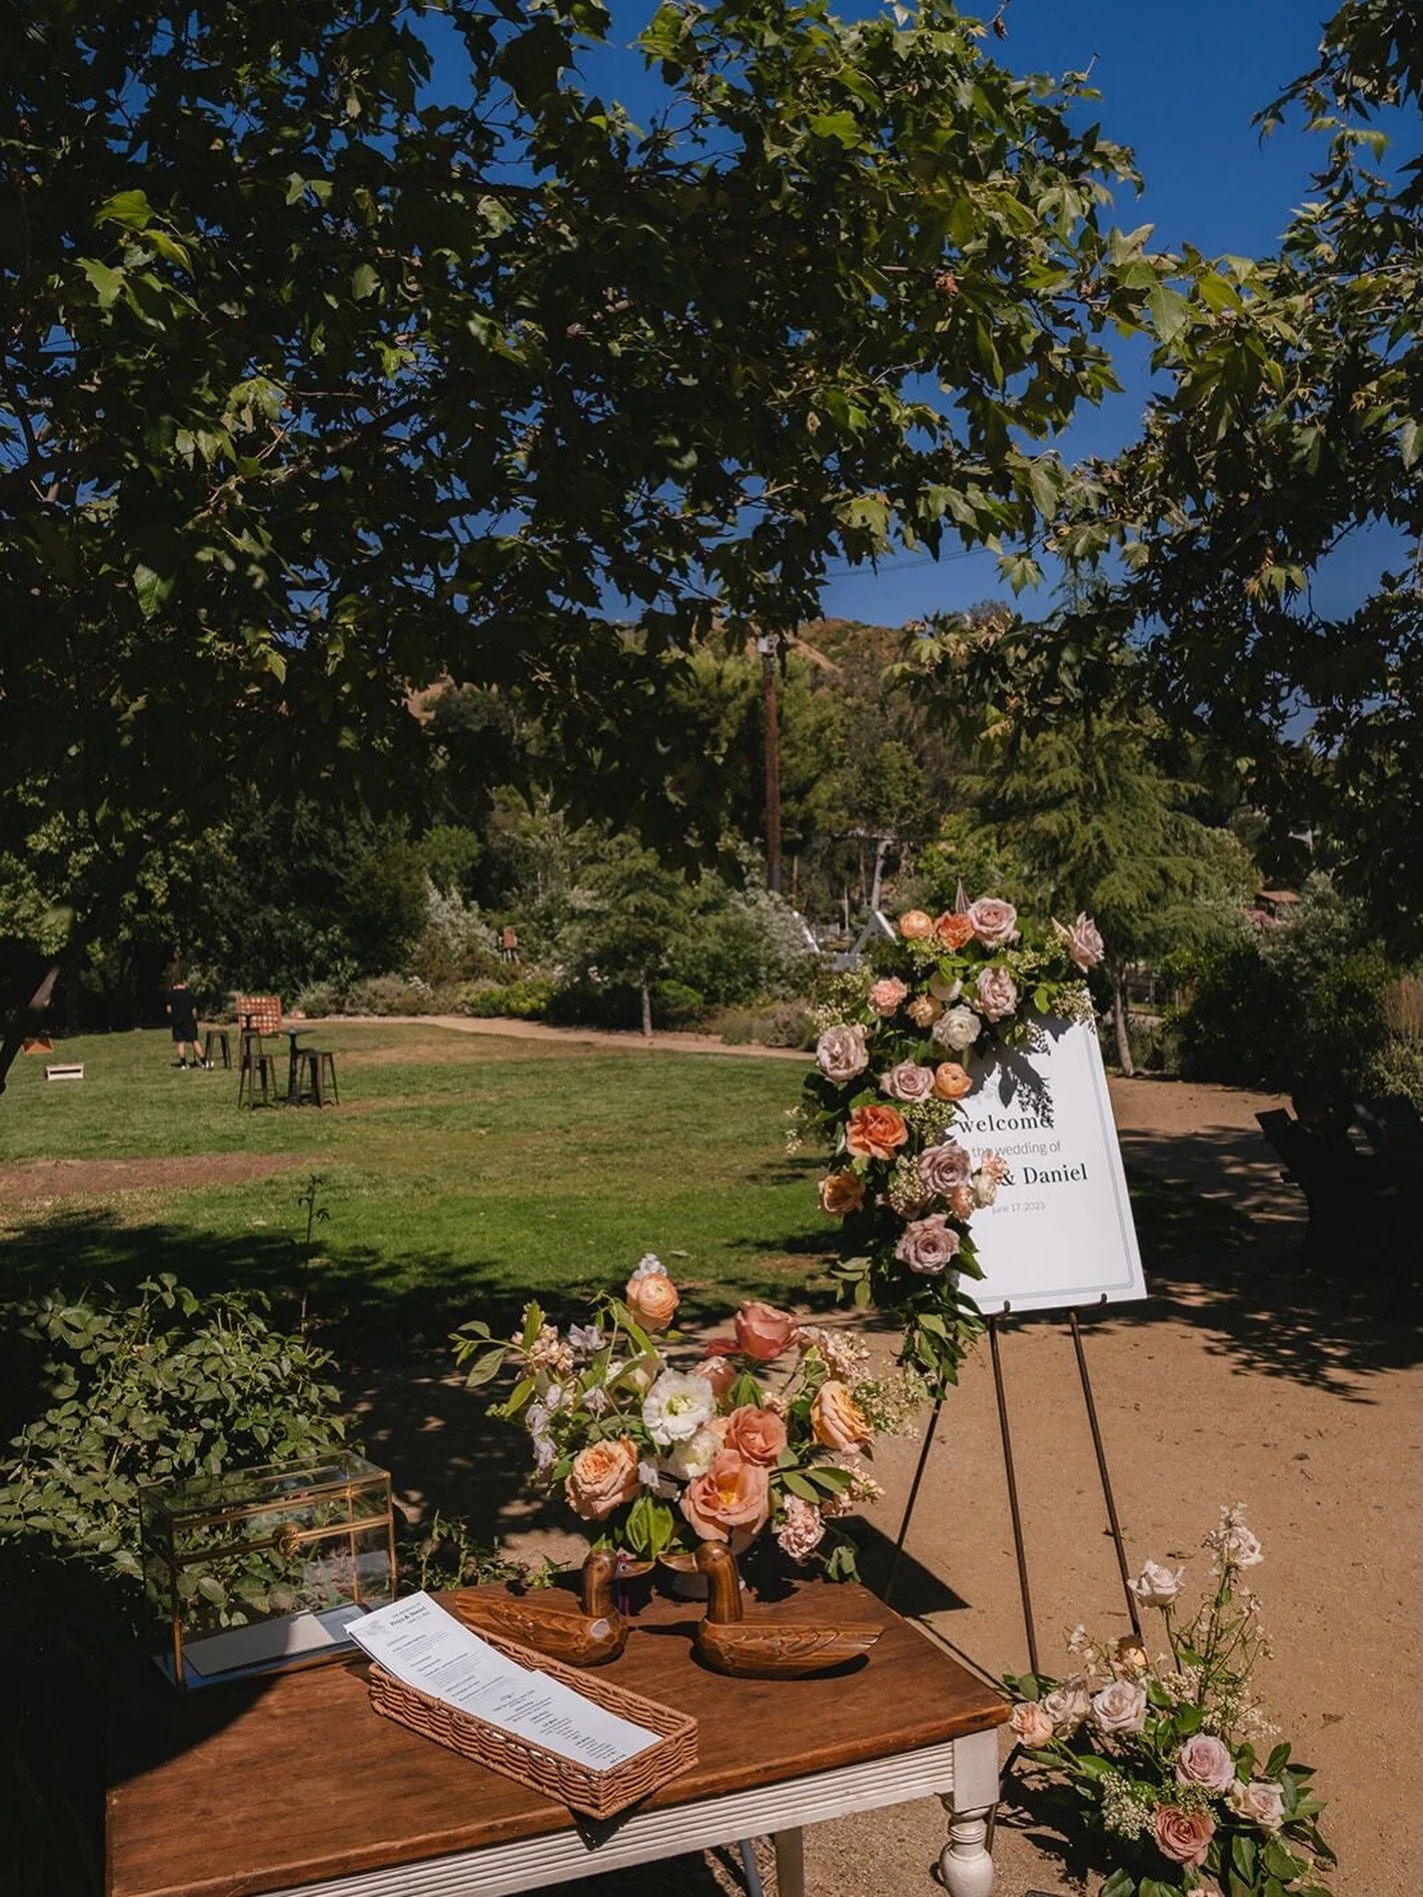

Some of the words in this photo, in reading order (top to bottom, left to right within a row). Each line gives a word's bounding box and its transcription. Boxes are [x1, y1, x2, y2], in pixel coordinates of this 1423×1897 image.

[957, 1115, 1052, 1133] welcome
[995, 1140, 1048, 1156] wedding
[1049, 1140, 1061, 1153] of
[1001, 1169, 1016, 1187] &
[1023, 1163, 1088, 1185] Daniel
